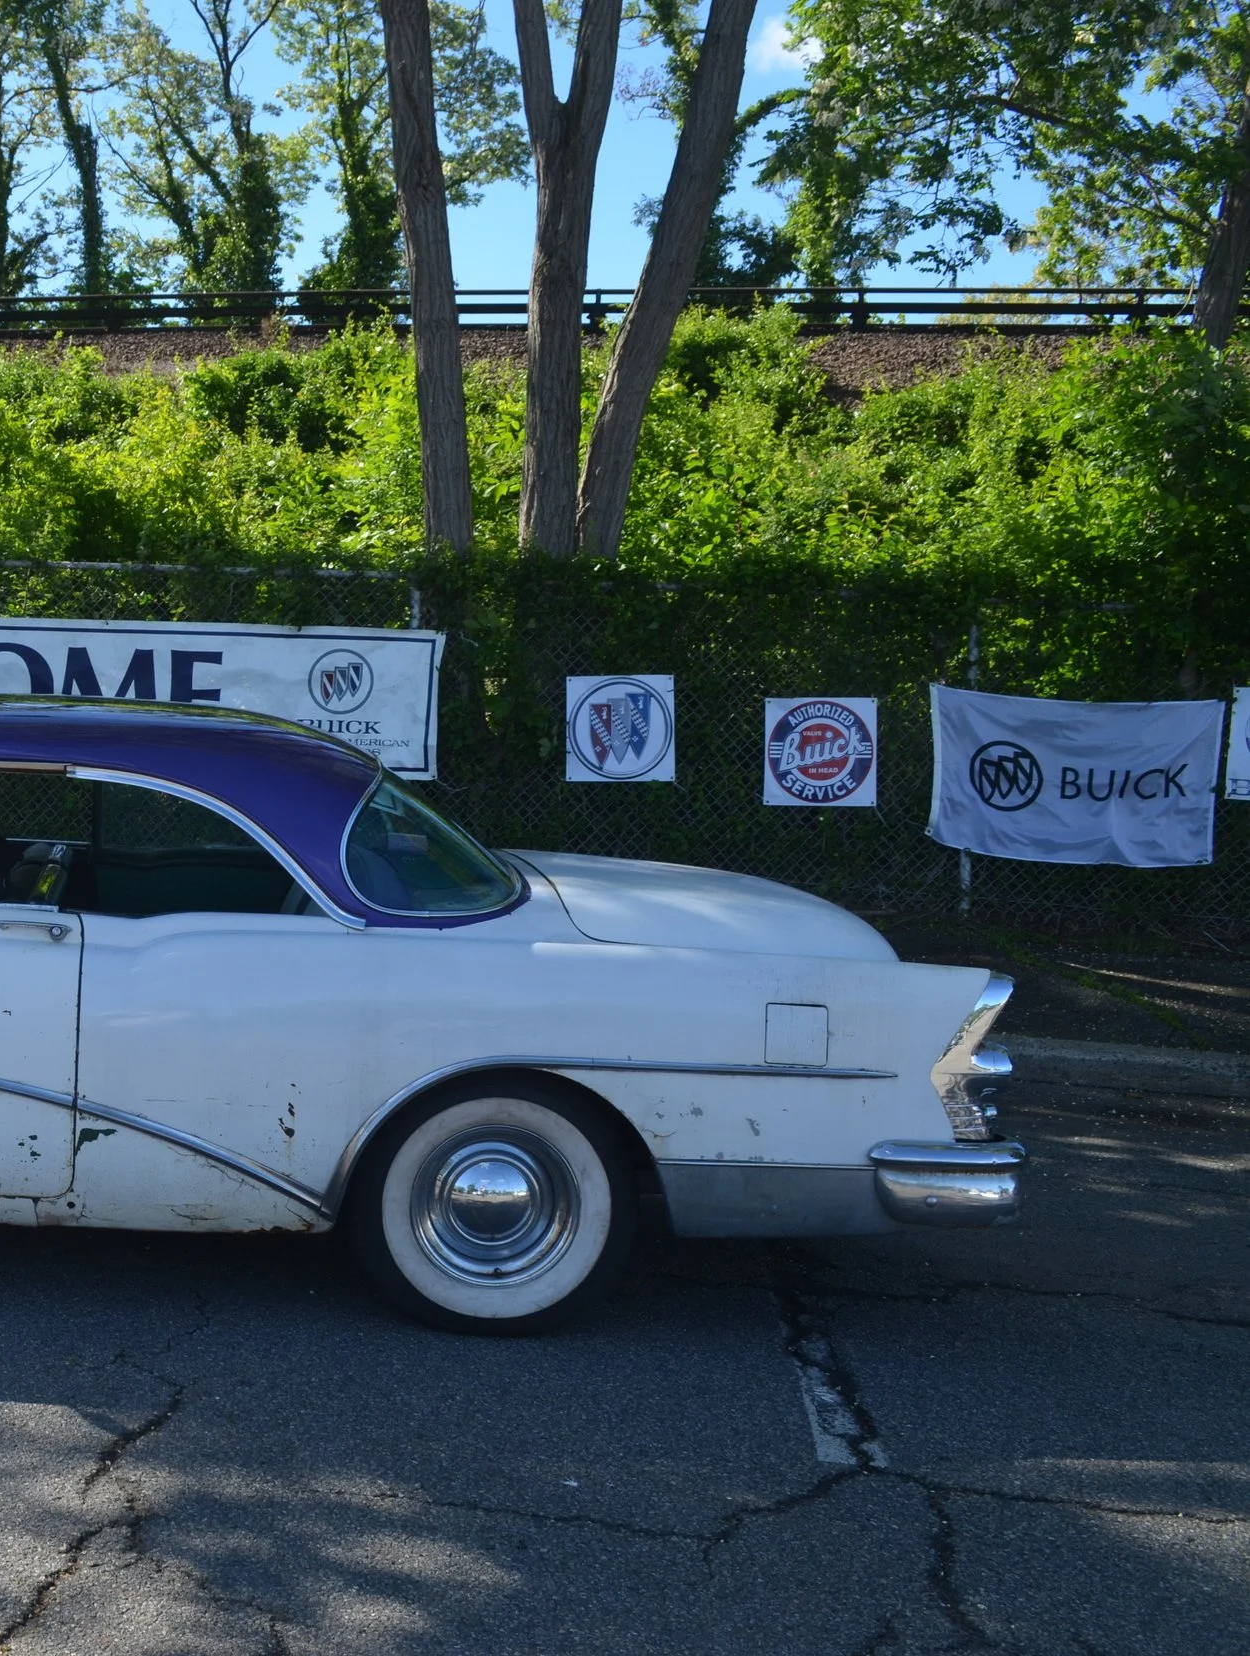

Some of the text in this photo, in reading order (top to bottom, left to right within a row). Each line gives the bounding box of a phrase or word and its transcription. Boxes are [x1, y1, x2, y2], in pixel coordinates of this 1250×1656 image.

[788, 704, 855, 727] AUTHORIZED
[777, 724, 866, 774] Buick
[781, 774, 857, 801] SERVICE
[1060, 762, 1189, 802] BUICK
